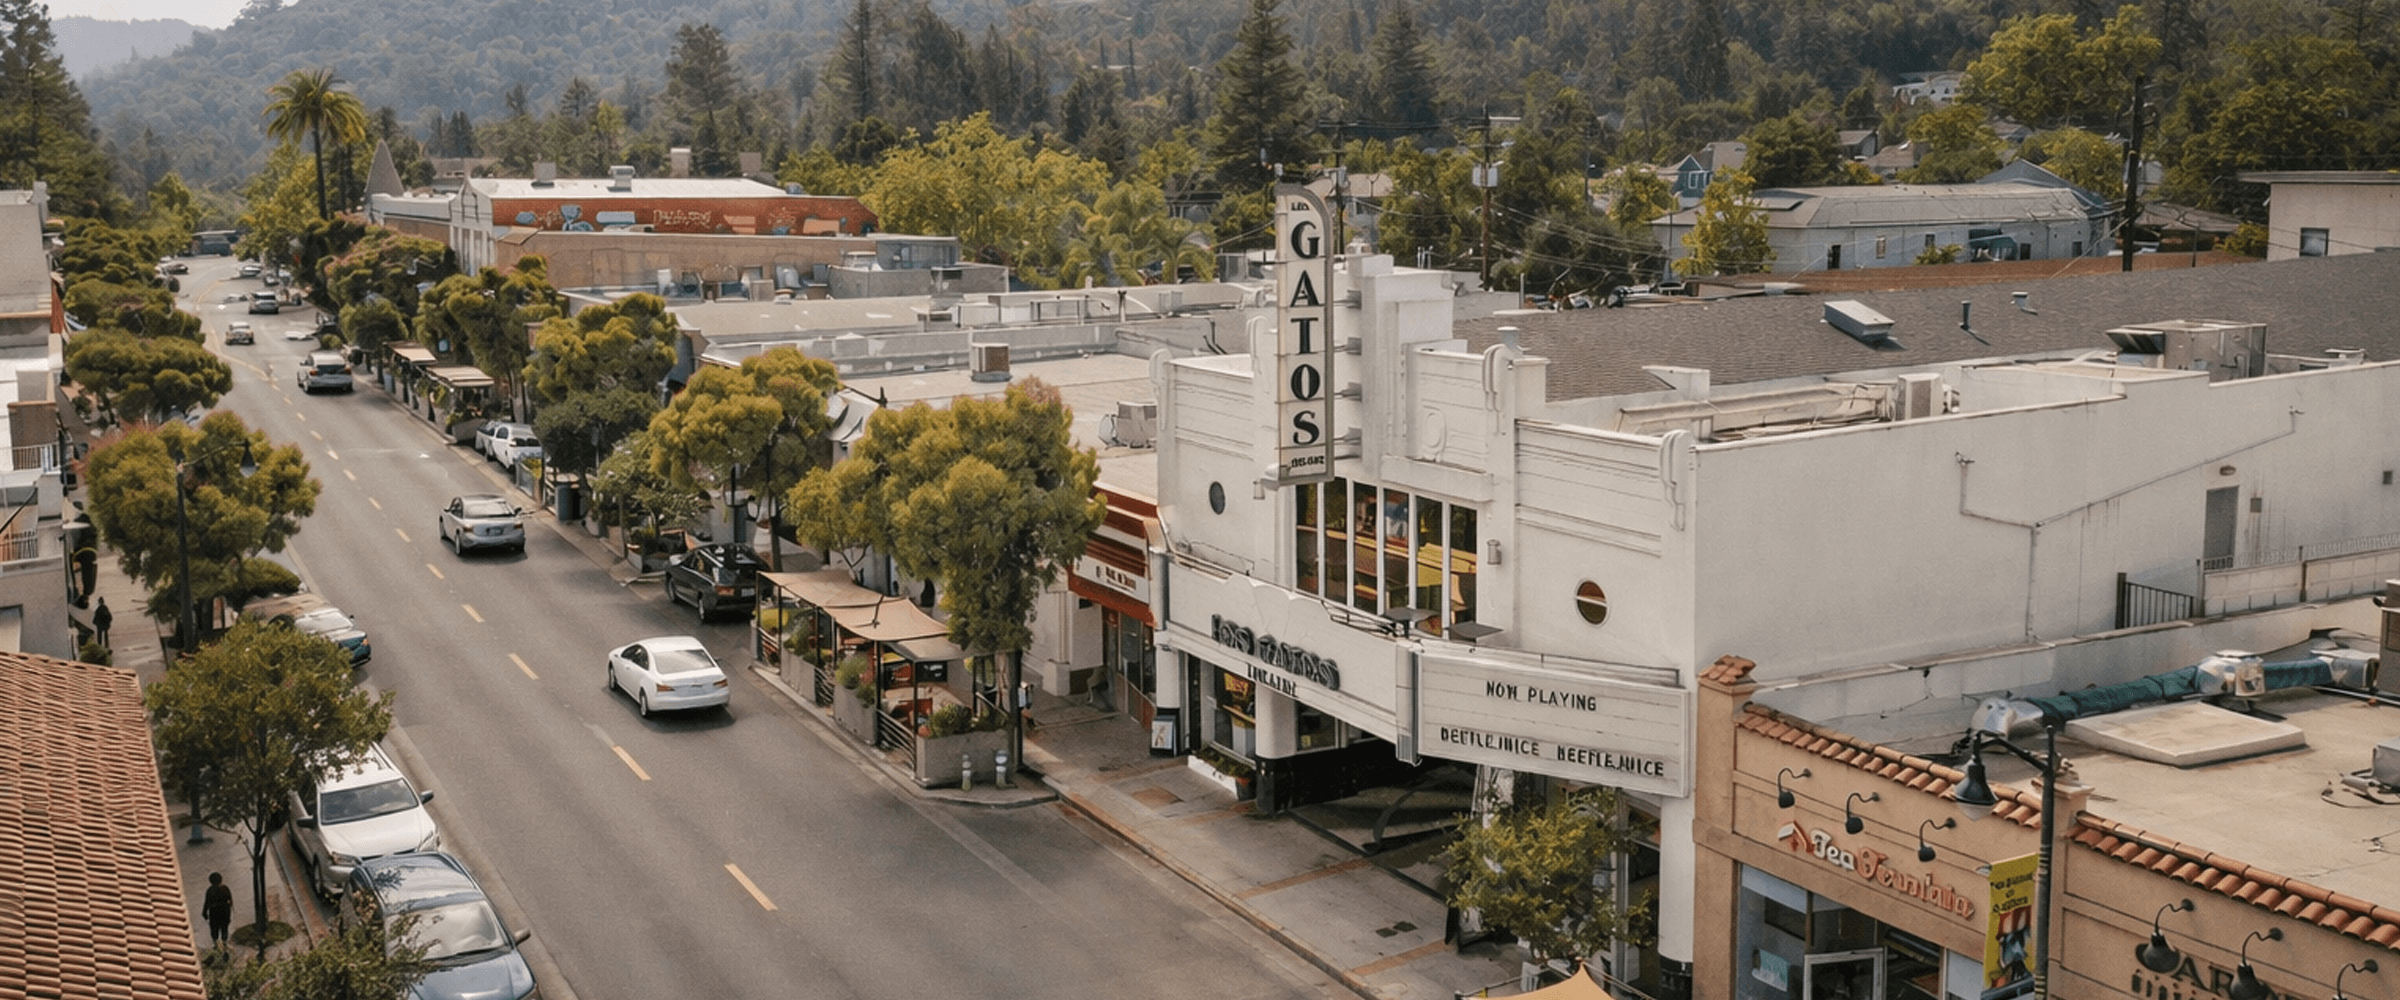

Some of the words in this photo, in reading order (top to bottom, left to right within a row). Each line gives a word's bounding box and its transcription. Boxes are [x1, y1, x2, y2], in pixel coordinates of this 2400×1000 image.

[1290, 220, 1321, 446] GATOS
[1486, 681, 1518, 700] NOW
[1528, 686, 1597, 712] PLAYING
